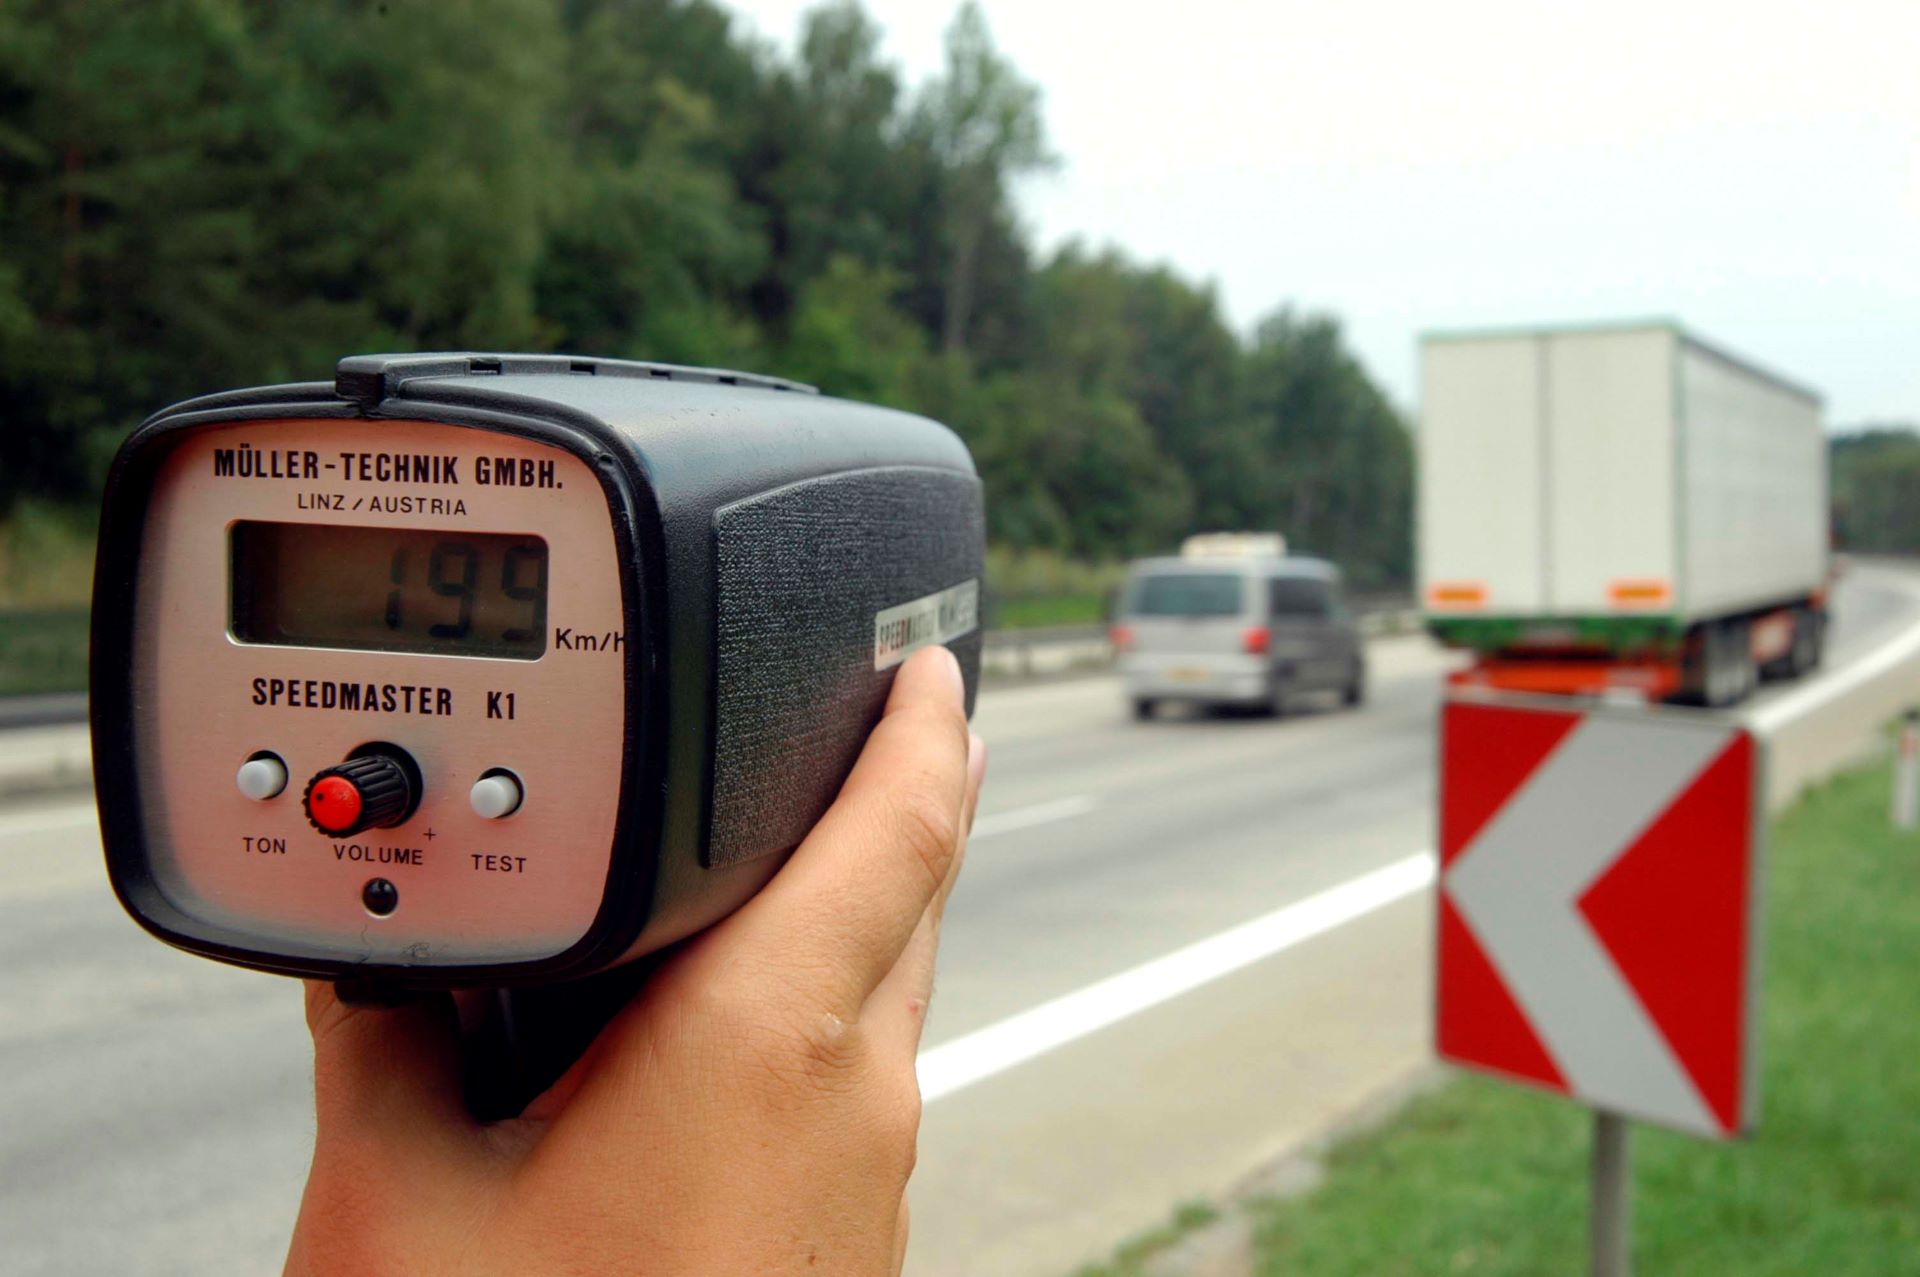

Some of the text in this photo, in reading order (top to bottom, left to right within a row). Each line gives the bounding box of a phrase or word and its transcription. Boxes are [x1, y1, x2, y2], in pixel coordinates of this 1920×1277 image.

[475, 456, 563, 489] GMBH.
[385, 542, 547, 641] 199
[555, 627, 624, 653] Km/h
[252, 677, 515, 720] SPEEDMASTER K1
[243, 836, 286, 855] TON
[333, 844, 423, 866] VOLUME
[471, 853, 527, 873] TEST
